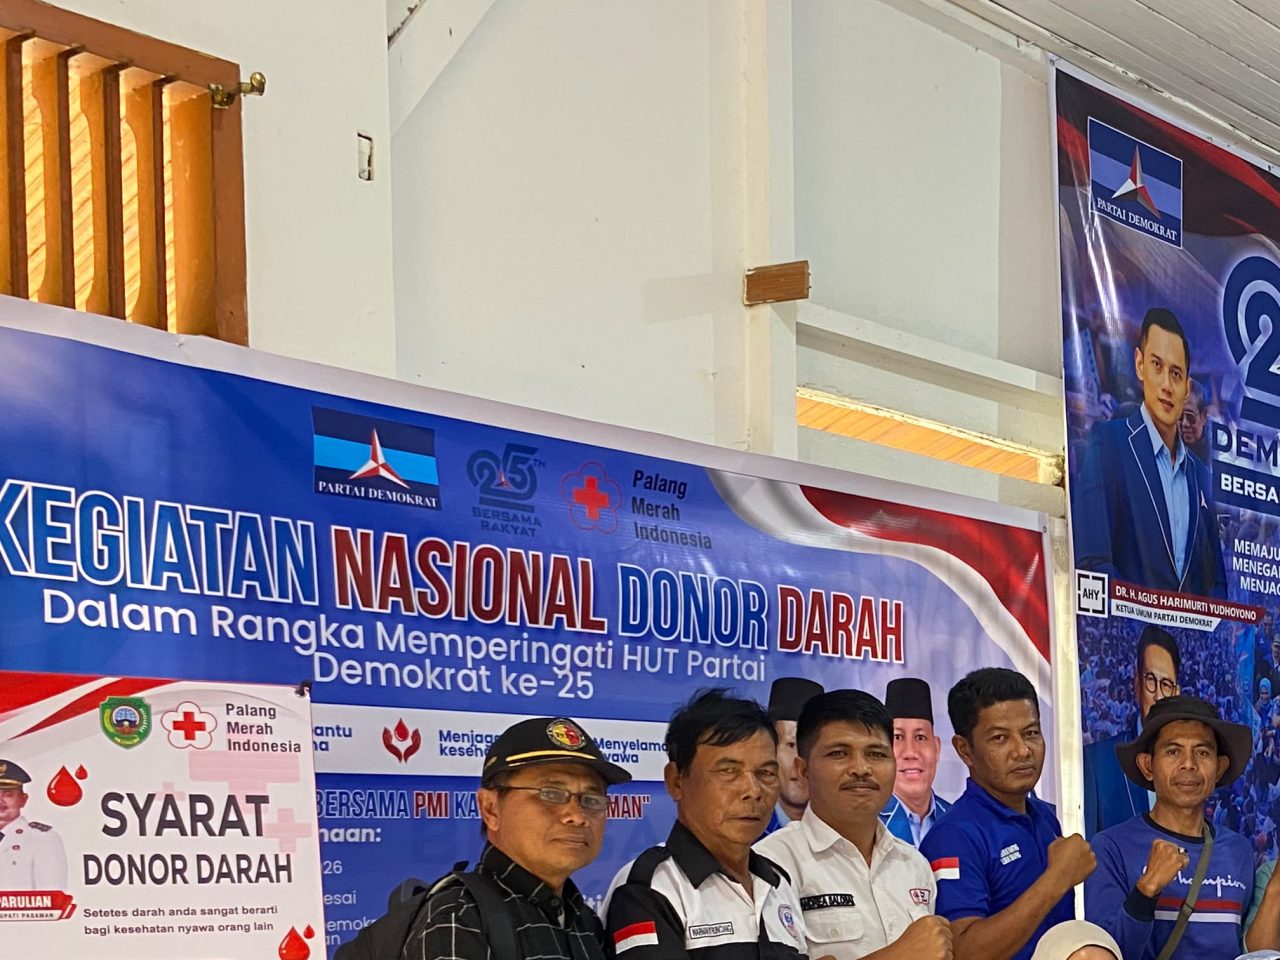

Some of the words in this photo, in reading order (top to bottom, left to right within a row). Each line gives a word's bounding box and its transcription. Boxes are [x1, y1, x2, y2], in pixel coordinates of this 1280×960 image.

[1097, 198, 1126, 222] PARTAI
[1127, 211, 1178, 242] DEMOKRAT
[318, 480, 364, 499] PARTAI
[368, 487, 439, 509] DEMOKRAT
[633, 470, 688, 500] Palang
[472, 506, 543, 528] BERSAMA
[632, 497, 681, 521] Merah
[480, 520, 537, 538] RAKYAT
[634, 522, 712, 551] Indonesia
[0, 478, 320, 606] KEGIATAN
[331, 526, 606, 634] NASIONAL
[617, 563, 768, 651] DONOR
[777, 584, 904, 665] DARAH
[1082, 587, 1100, 601] AHY
[1115, 585, 1129, 599] DR.
[1130, 589, 1138, 600] H.
[1137, 591, 1158, 605] AGUS
[1160, 596, 1208, 613] HARIMURTI
[1209, 604, 1257, 621] YUDHOYONO
[1115, 603, 1135, 615] KETUA
[1135, 608, 1152, 619] UMUM
[1153, 612, 1178, 623] PARTAI
[1179, 616, 1213, 628] DEMOKRAT
[43, 588, 198, 636] Dalam
[210, 604, 365, 656] Rangka
[376, 621, 613, 672] Memperingati
[622, 646, 680, 676] HUT
[686, 652, 766, 682] Partai
[313, 651, 491, 695] Demokrat
[501, 663, 594, 700] ke-25
[225, 703, 277, 720] Palang
[226, 722, 274, 736] Merah
[227, 738, 302, 754] Indonesia
[101, 792, 270, 838] SYARAT
[413, 790, 450, 820] PMI
[83, 854, 190, 886] DONOR
[196, 853, 293, 885] DARAH
[0, 895, 52, 908] ARULIAN
[83, 907, 128, 919] Setetes
[131, 906, 165, 917] darah
[168, 906, 197, 917] anda
[200, 906, 239, 920] sangat
[242, 905, 278, 916] berarti
[84, 924, 111, 937] bagi
[114, 923, 175, 934] kesehatan
[178, 925, 215, 936] nyawa
[217, 924, 251, 936] orang
[253, 921, 274, 932] lain
